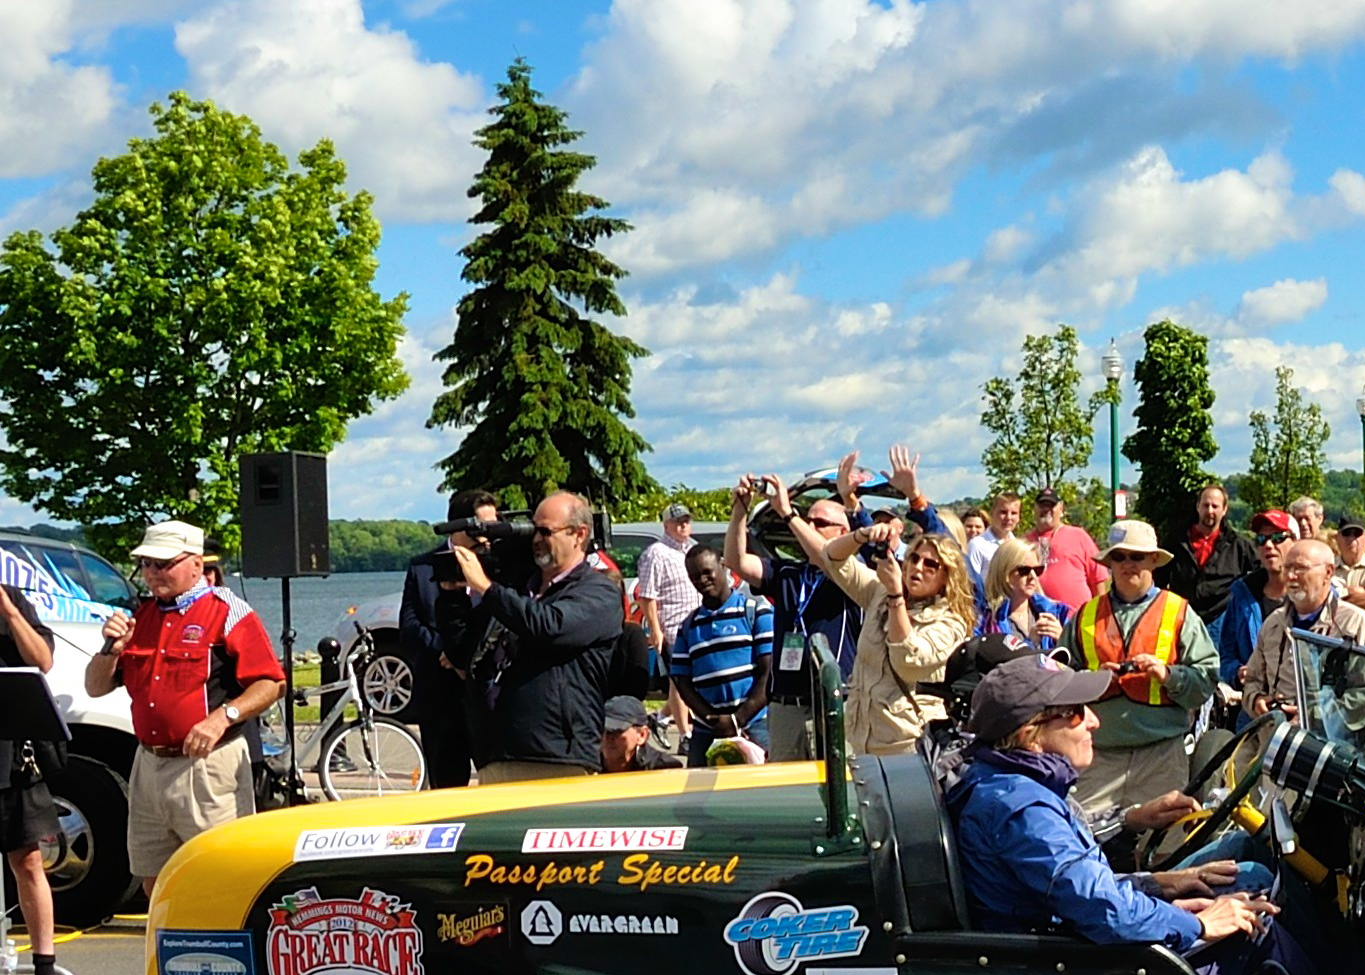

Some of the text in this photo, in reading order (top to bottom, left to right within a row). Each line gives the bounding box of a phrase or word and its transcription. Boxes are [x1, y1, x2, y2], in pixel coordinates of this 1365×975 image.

[301, 831, 381, 851] Follow
[529, 829, 686, 850] TIMEWISE
[465, 853, 740, 891] Passport Special
[292, 904, 388, 928] HEMMINGS MOTOR NEWS
[437, 904, 505, 944] Meguiar's
[727, 908, 856, 942] COKER
[774, 929, 866, 960] TIRE
